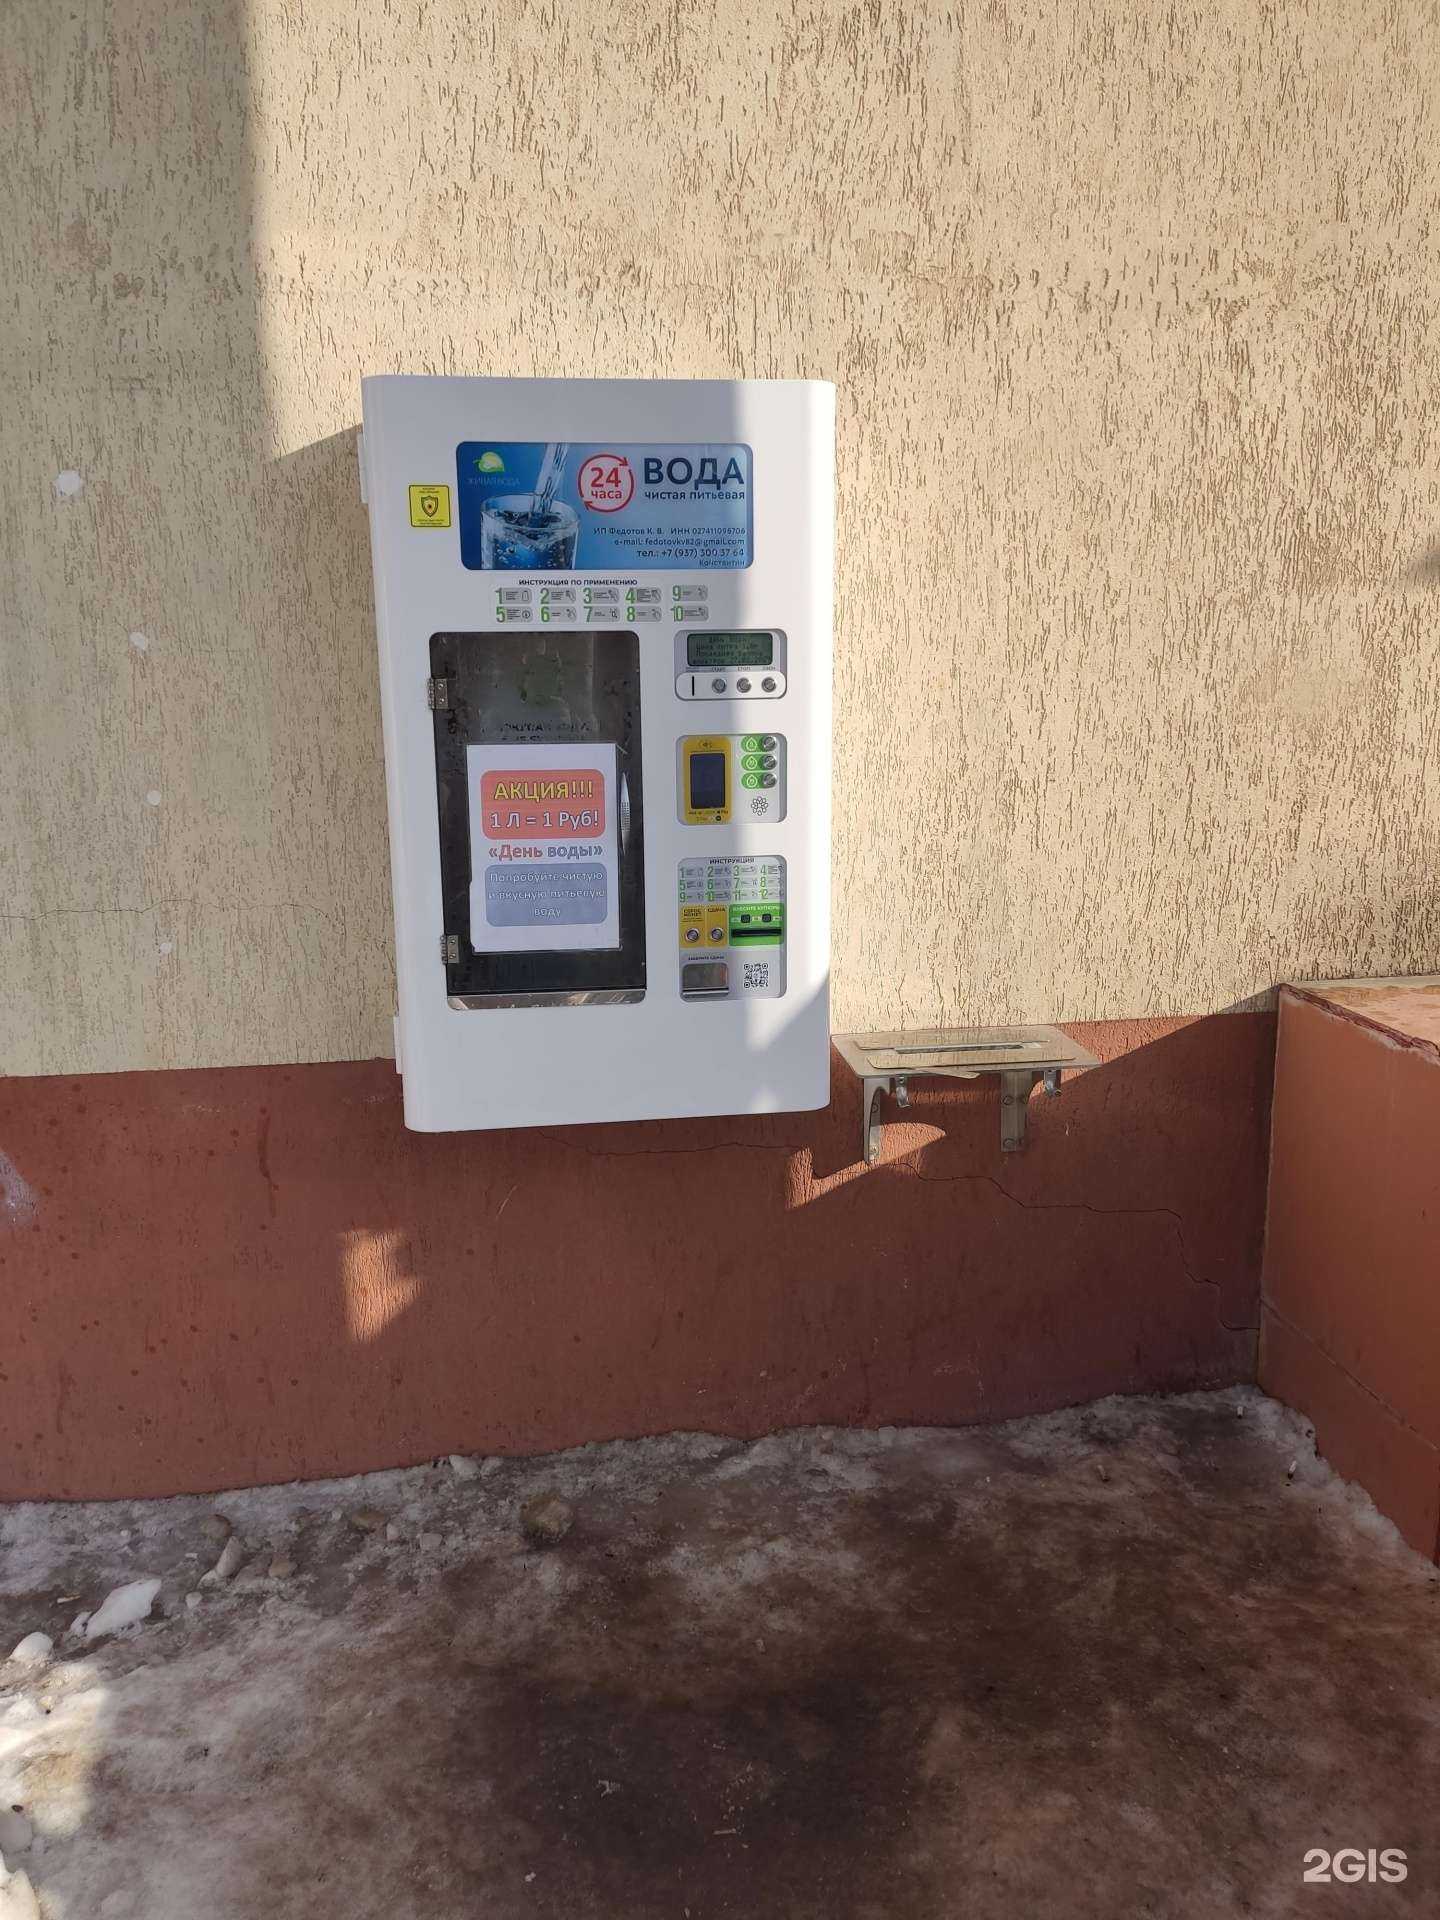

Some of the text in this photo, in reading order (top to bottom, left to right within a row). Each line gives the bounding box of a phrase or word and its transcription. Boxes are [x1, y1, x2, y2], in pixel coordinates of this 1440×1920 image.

[591, 467, 621, 488] 24
[644, 457, 744, 490] ВОДА
[591, 490, 622, 499] часа
[644, 490, 745, 500] чистая питьевая
[593, 527, 607, 535] ИП
[609, 527, 645, 536] Федотов
[647, 527, 653, 535] К.
[671, 527, 691, 535] ИНН
[645, 537, 745, 547] fedotovkv82@gmail.com
[637, 549, 659, 557] тел.:
[661, 549, 672, 557] +7
[674, 549, 697, 558] (937)
[701, 549, 717, 557] 300
[720, 549, 731, 557] 37
[700, 559, 745, 567] Константин
[495, 588, 503, 604] 1
[540, 588, 549, 604] 2
[583, 587, 592, 604] 3
[625, 587, 636, 604] 4
[672, 585, 681, 601] 9
[496, 606, 505, 622] 5
[541, 606, 550, 622] 6
[583, 606, 593, 622] 7
[627, 606, 636, 622] 8
[671, 605, 684, 622] 10
[494, 781, 592, 803] АКЦИЯ!!!
[491, 811, 599, 830] 1 Л = 1 Руб!
[489, 844, 603, 861] «День воды»
[680, 867, 685, 878] 1
[707, 866, 714, 878] 2
[733, 865, 740, 876] 3
[760, 864, 766, 875] 4
[490, 871, 603, 883] Попробуйте чистую
[760, 877, 766, 887] 8
[680, 879, 686, 891] 5
[707, 878, 714, 889] 6
[733, 878, 740, 888] 7
[499, 890, 547, 900] вкусную
[550, 889, 605, 899] питьевую
[680, 891, 686, 902] 9
[705, 890, 714, 901] 10
[732, 890, 740, 901] 11
[759, 889, 768, 899] 12
[534, 907, 561, 918] воду
